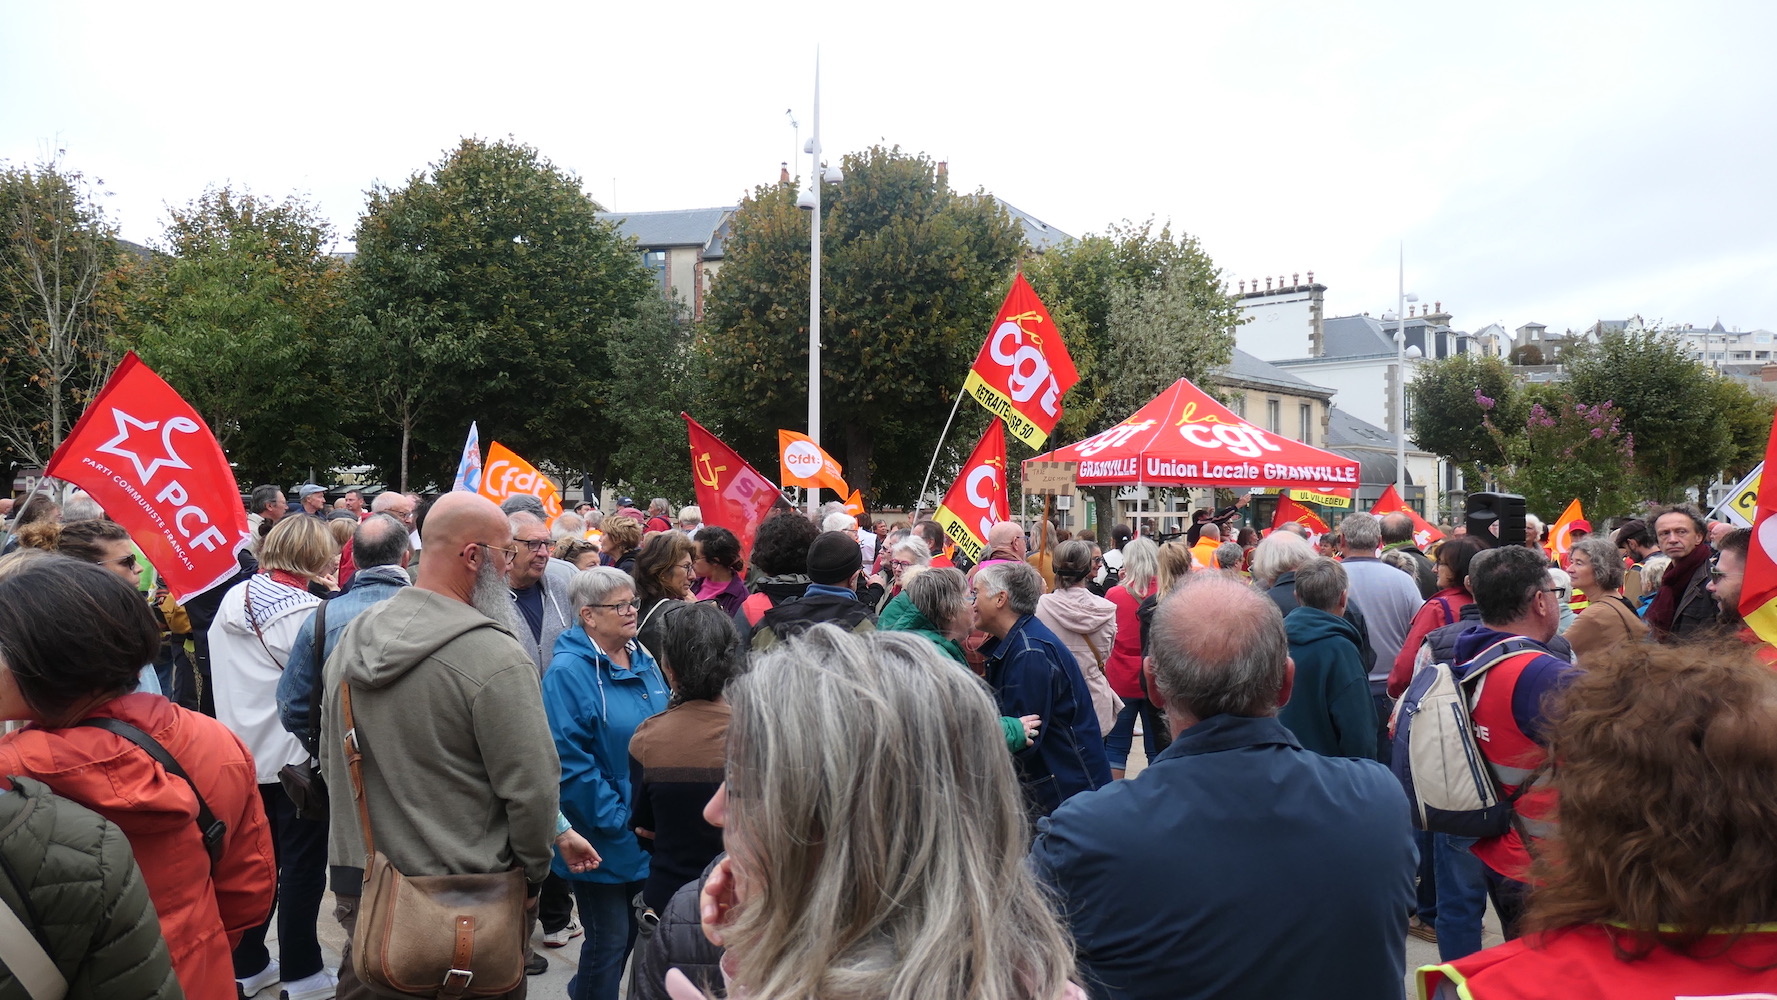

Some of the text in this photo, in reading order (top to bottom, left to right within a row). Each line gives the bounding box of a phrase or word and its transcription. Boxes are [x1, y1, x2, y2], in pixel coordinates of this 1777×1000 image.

[990, 322, 1060, 417] cgt
[1175, 402, 1242, 427] la
[1019, 423, 1034, 439] 50
[1179, 422, 1282, 458] cgt
[1080, 457, 1137, 478] GRANVILLE
[1147, 458, 1357, 483] Union Locale GRANVILLE
[1249, 487, 1284, 496] SUBWAY
[1300, 491, 1345, 507] UL VILLEDIEU
[82, 457, 194, 571] PARTI COMMUNISTE FRANÇAIS
[155, 480, 228, 552] PCF
[946, 520, 982, 562] RETRAITE
